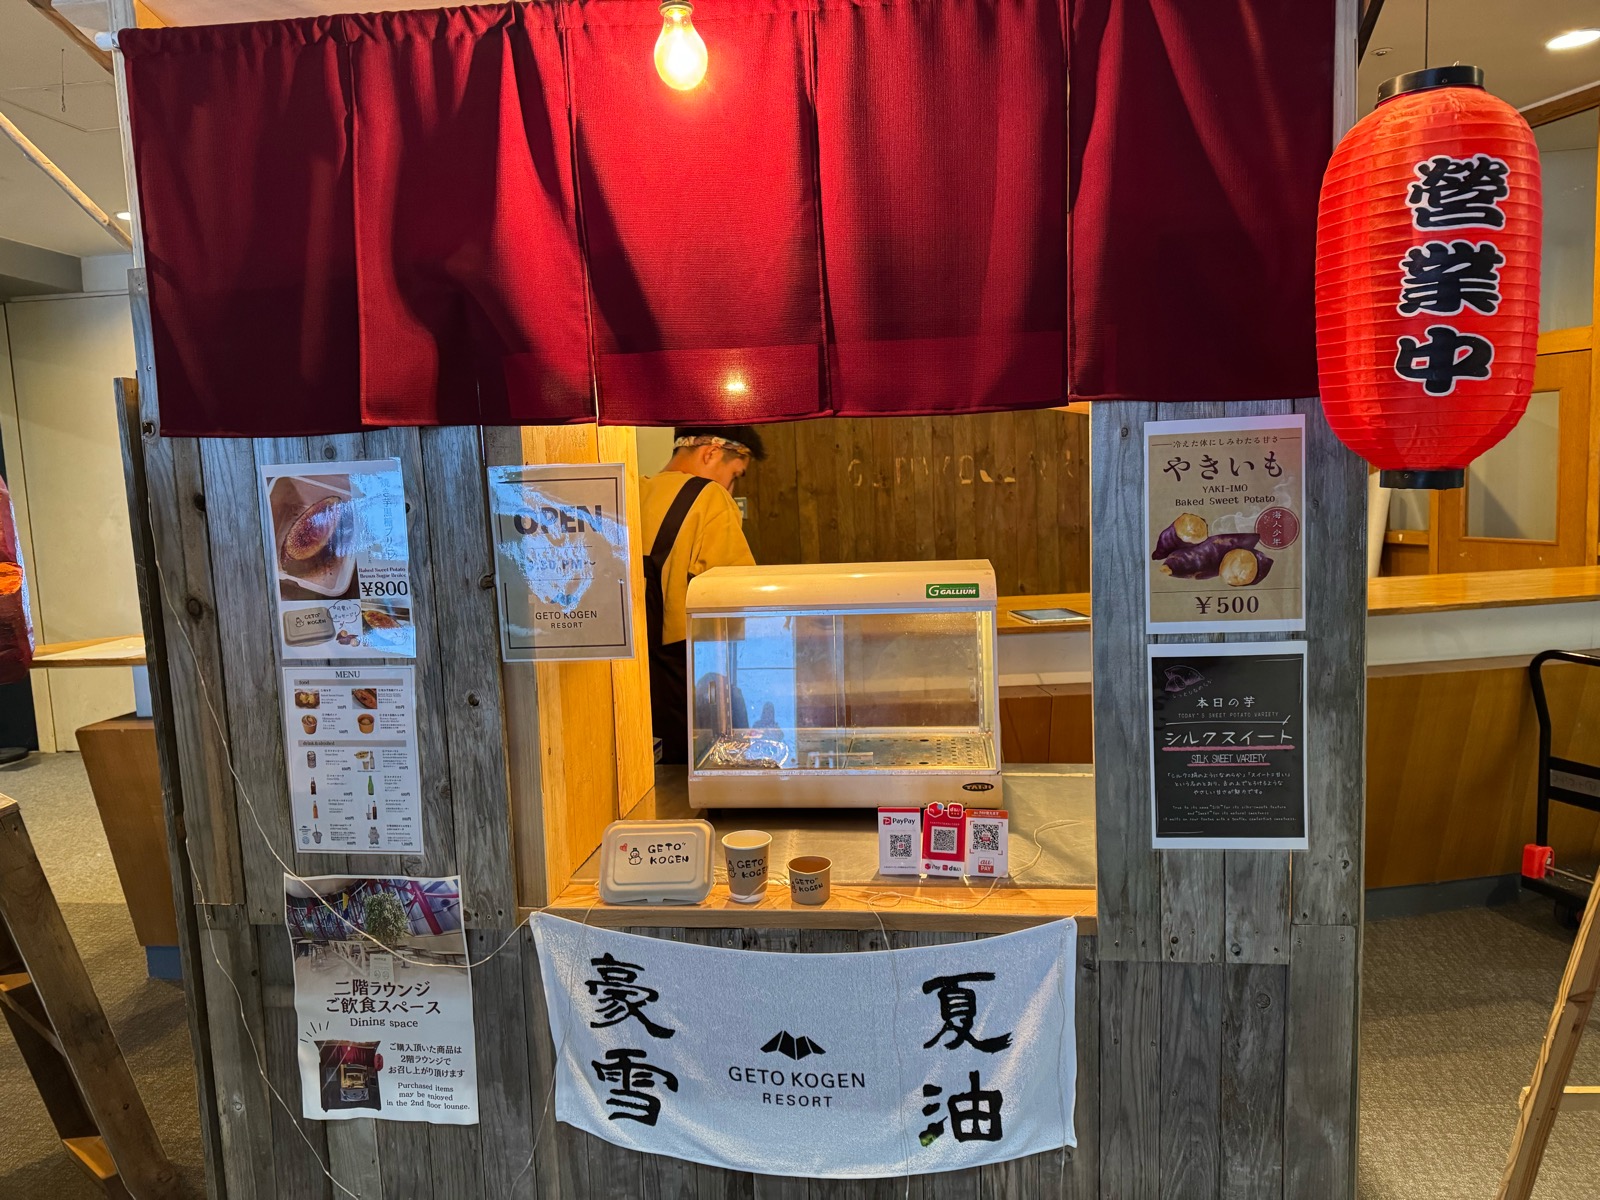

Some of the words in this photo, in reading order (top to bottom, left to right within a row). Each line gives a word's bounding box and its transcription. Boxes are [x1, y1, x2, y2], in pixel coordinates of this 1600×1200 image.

[1173, 436, 1278, 448] 冷えた体にしみわたる甘さ
[1163, 451, 1282, 481] やきいも
[1202, 484, 1248, 493] YAKI-IMO
[1209, 497, 1239, 505] Sweet
[1244, 495, 1275, 503] Potato
[514, 505, 602, 534] OPEN
[361, 581, 408, 596] ¥800
[535, 611, 561, 620] GETO
[563, 610, 597, 619] KOGEN
[335, 670, 360, 678] MENU
[1196, 696, 1255, 708] 本日の芋
[1165, 729, 1293, 745] シルクスイート
[1191, 755, 1209, 763] SILK
[1212, 754, 1233, 763] SWEET
[1236, 754, 1267, 763] VARIETY
[892, 817, 915, 825] PayPay
[650, 855, 690, 865] KOGEN
[798, 884, 823, 892] KOGEN
[334, 979, 430, 998] 二階ラウンジ
[326, 996, 441, 1014] ご飲食スペース
[350, 1017, 385, 1027] Dining
[389, 1020, 418, 1028] space
[585, 952, 679, 1127] 豪雪
[389, 1042, 462, 1054] ご購入頂いた商品は
[400, 1055, 452, 1065] 2階ラウンジで
[919, 971, 1013, 1146] 夏油
[388, 1065, 465, 1078] お召し上がり頂けます
[728, 1066, 785, 1086] GETO
[791, 1072, 865, 1088] KOGEN
[398, 1082, 433, 1091] Purchased
[427, 1101, 442, 1109] floor
[763, 1092, 832, 1107] RESORT
